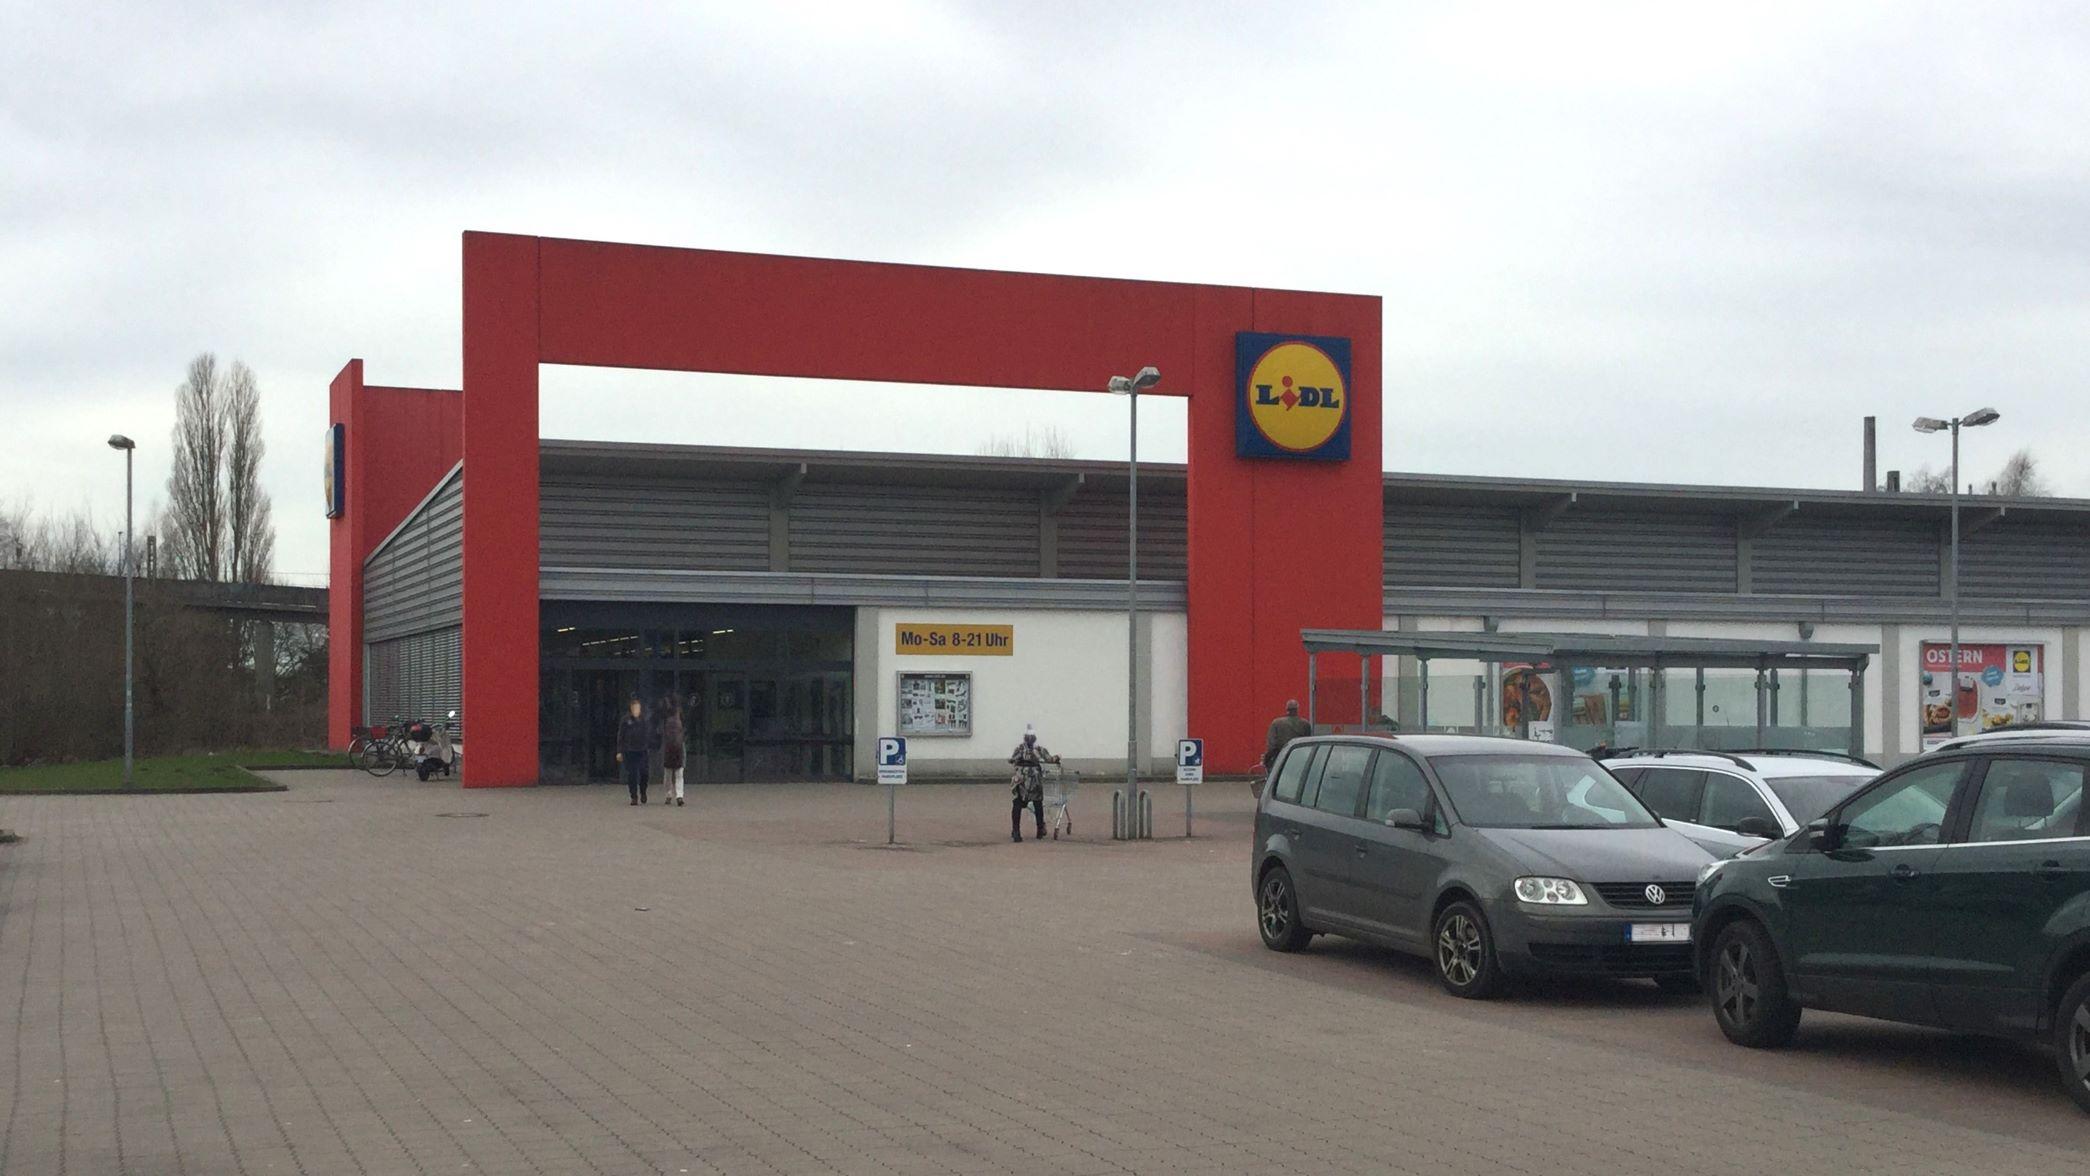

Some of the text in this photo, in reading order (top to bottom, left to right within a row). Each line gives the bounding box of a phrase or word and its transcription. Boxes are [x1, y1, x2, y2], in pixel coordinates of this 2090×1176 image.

[901, 631, 1009, 648] Mo-Sa 8-21 Uhr
[880, 739, 900, 765] P
[1179, 740, 1197, 766] P
